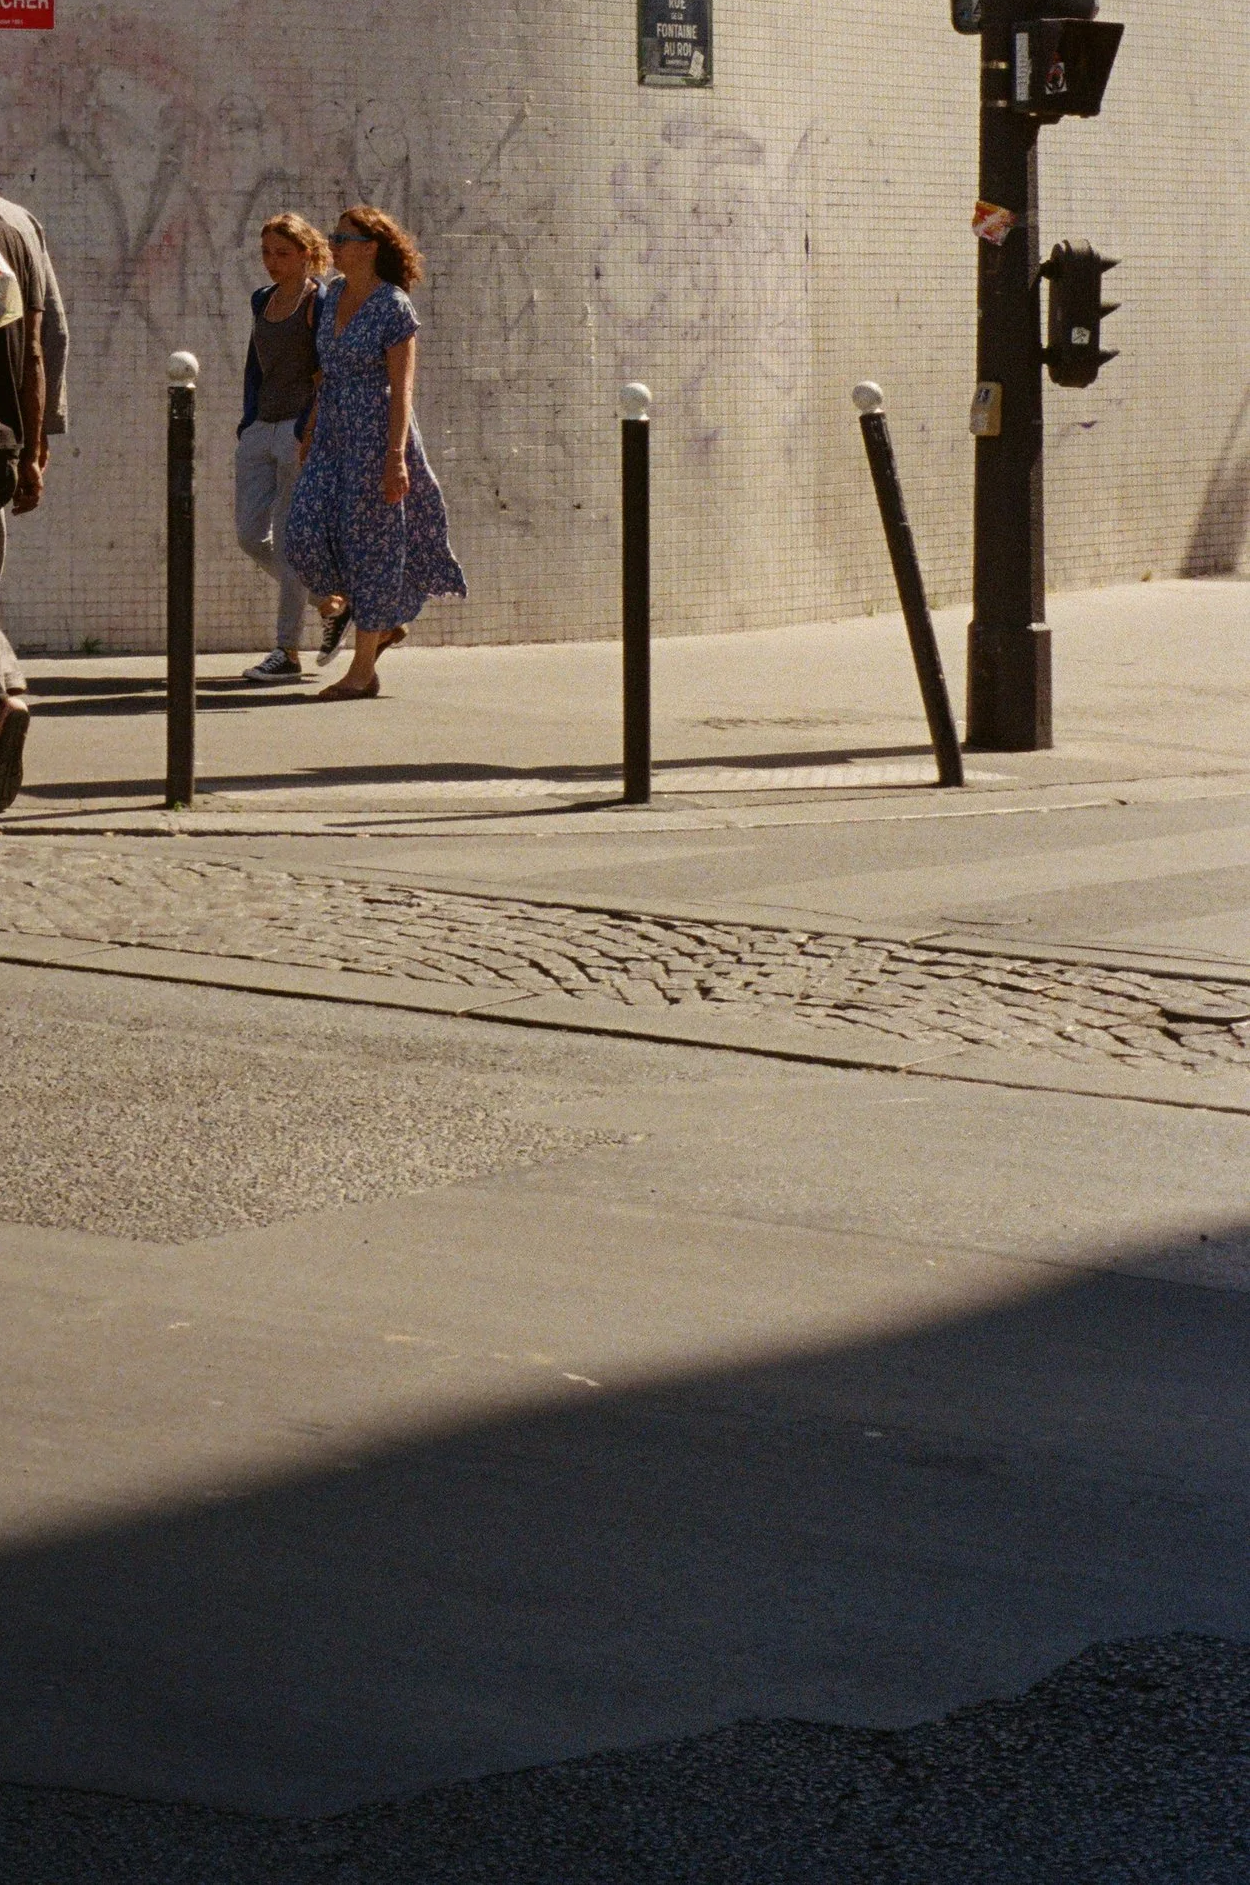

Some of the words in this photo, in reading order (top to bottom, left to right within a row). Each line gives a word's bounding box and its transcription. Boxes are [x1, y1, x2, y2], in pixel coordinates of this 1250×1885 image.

[656, 23, 698, 39] FONTAINE
[663, 41, 675, 56] AU
[677, 42, 692, 57] ROI
